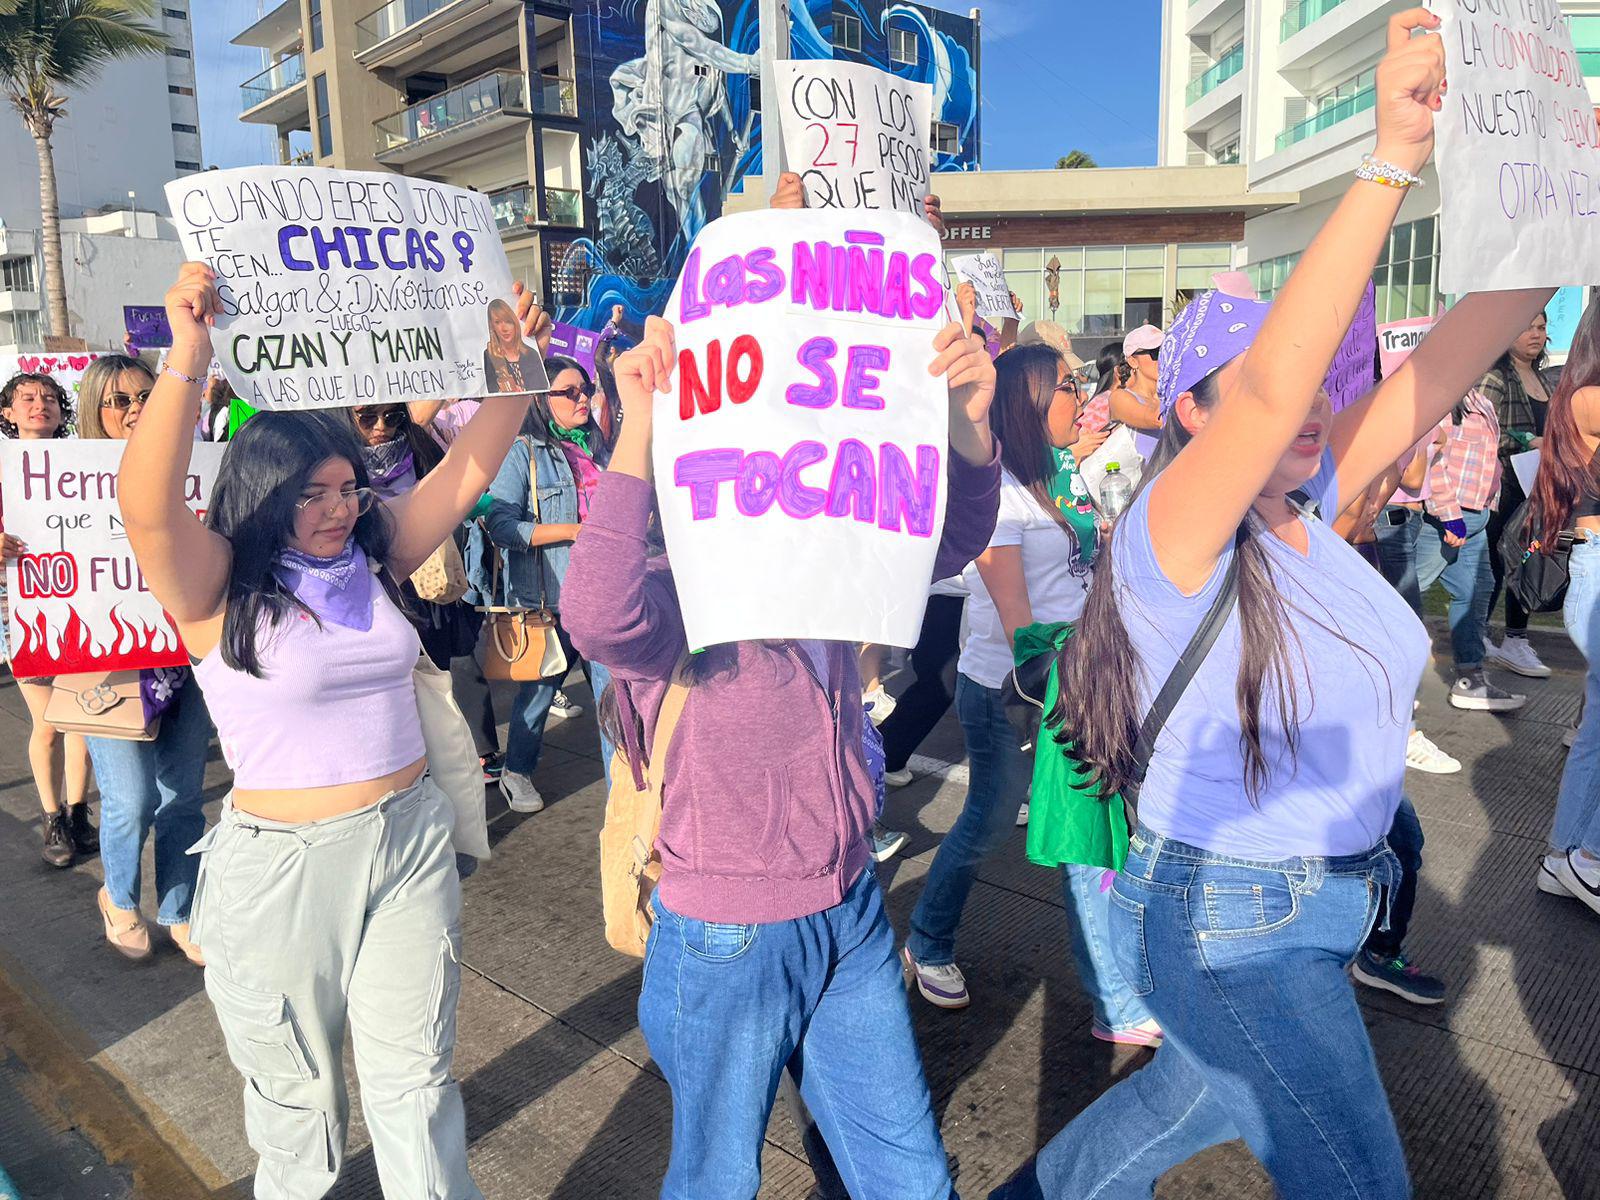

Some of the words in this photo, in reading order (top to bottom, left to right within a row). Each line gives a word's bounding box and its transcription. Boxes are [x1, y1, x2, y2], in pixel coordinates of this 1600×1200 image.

[1458, 19, 1488, 69] LA
[791, 74, 857, 121] CON
[875, 84, 916, 137] LOS
[1461, 88, 1547, 139] NUESTRO
[806, 122, 859, 168] 27
[878, 132, 926, 184] PESOS
[183, 177, 324, 228] CUANDO
[328, 180, 405, 224] ERES
[412, 187, 492, 235] JOVEN
[801, 168, 880, 209] QUE
[890, 172, 922, 218] ME
[1498, 161, 1558, 220] OTRA
[1561, 168, 1598, 217] VEZ
[188, 226, 233, 252] TE
[277, 223, 446, 273] CHICAS
[205, 253, 284, 279] ICEN...
[790, 229, 944, 321] NIÑAS
[217, 280, 314, 328] Salgan
[315, 273, 343, 313] &
[232, 330, 328, 374] CAZAN
[330, 330, 353, 366] Y
[370, 326, 444, 368] MATAN
[1382, 329, 1431, 350] Tran
[253, 380, 268, 404] A
[267, 375, 300, 403] LAS
[308, 374, 346, 402] QUE
[353, 373, 376, 399] LO
[386, 368, 446, 397] HACEN
[677, 333, 765, 421] NO
[785, 335, 891, 411] SE
[23, 450, 202, 500] Herma
[673, 437, 940, 538] TOCAN
[45, 512, 92, 552] que
[17, 551, 80, 598] NO
